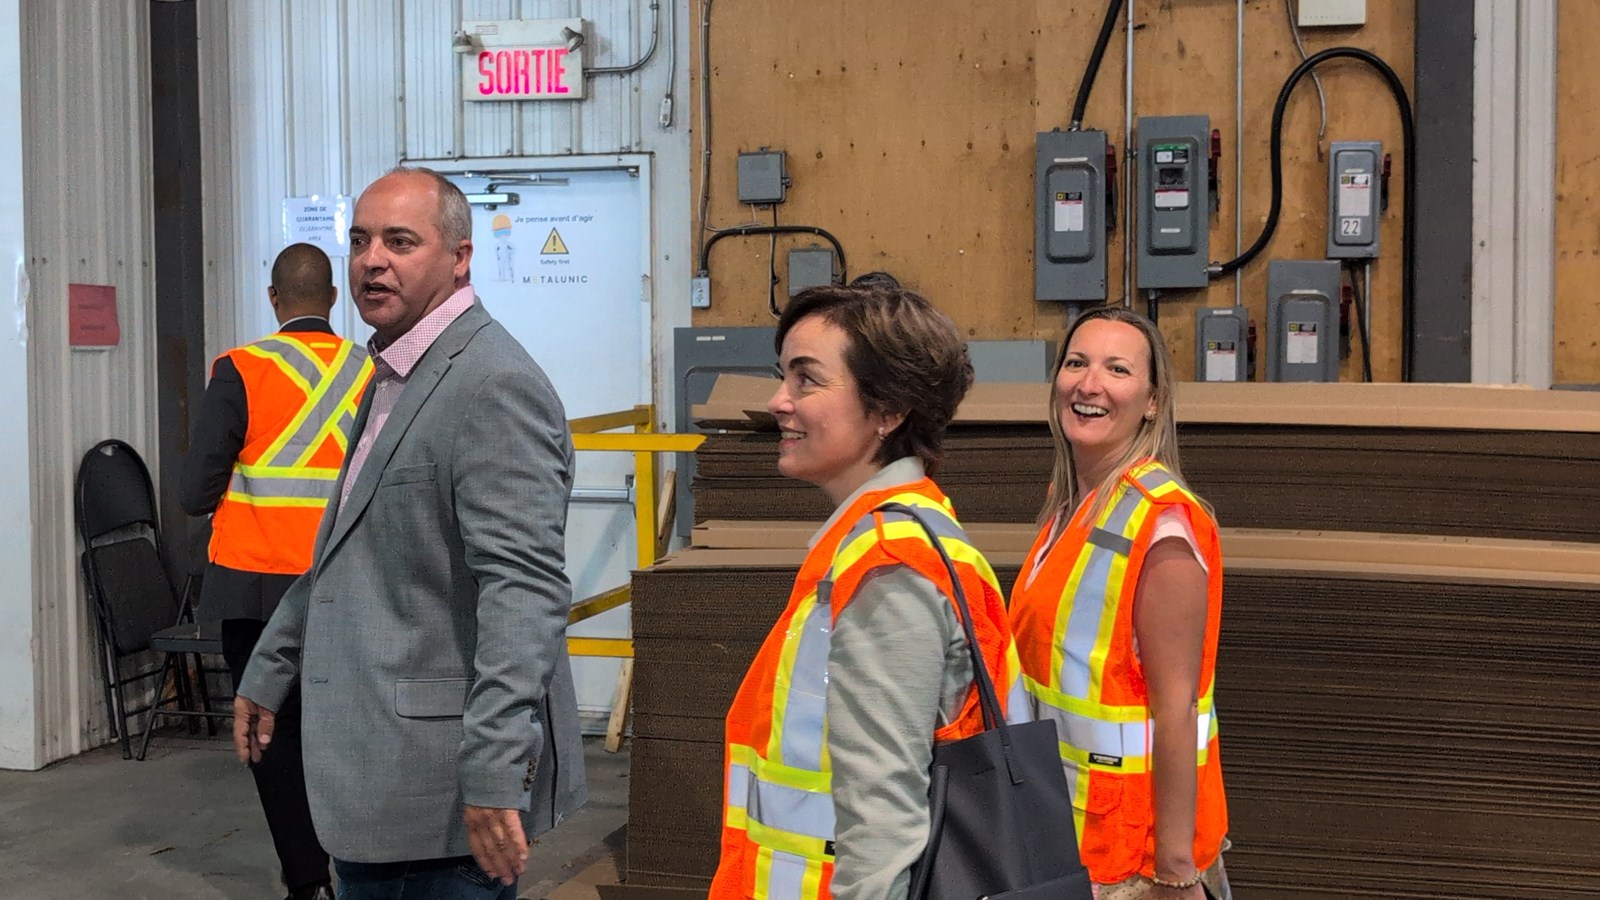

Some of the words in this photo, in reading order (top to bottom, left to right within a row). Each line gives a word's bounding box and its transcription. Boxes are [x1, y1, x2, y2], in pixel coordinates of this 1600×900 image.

[478, 48, 570, 95] SORTIE
[525, 216, 548, 224] pense
[571, 214, 594, 223] d'agir
[1343, 220, 1359, 235] 22
